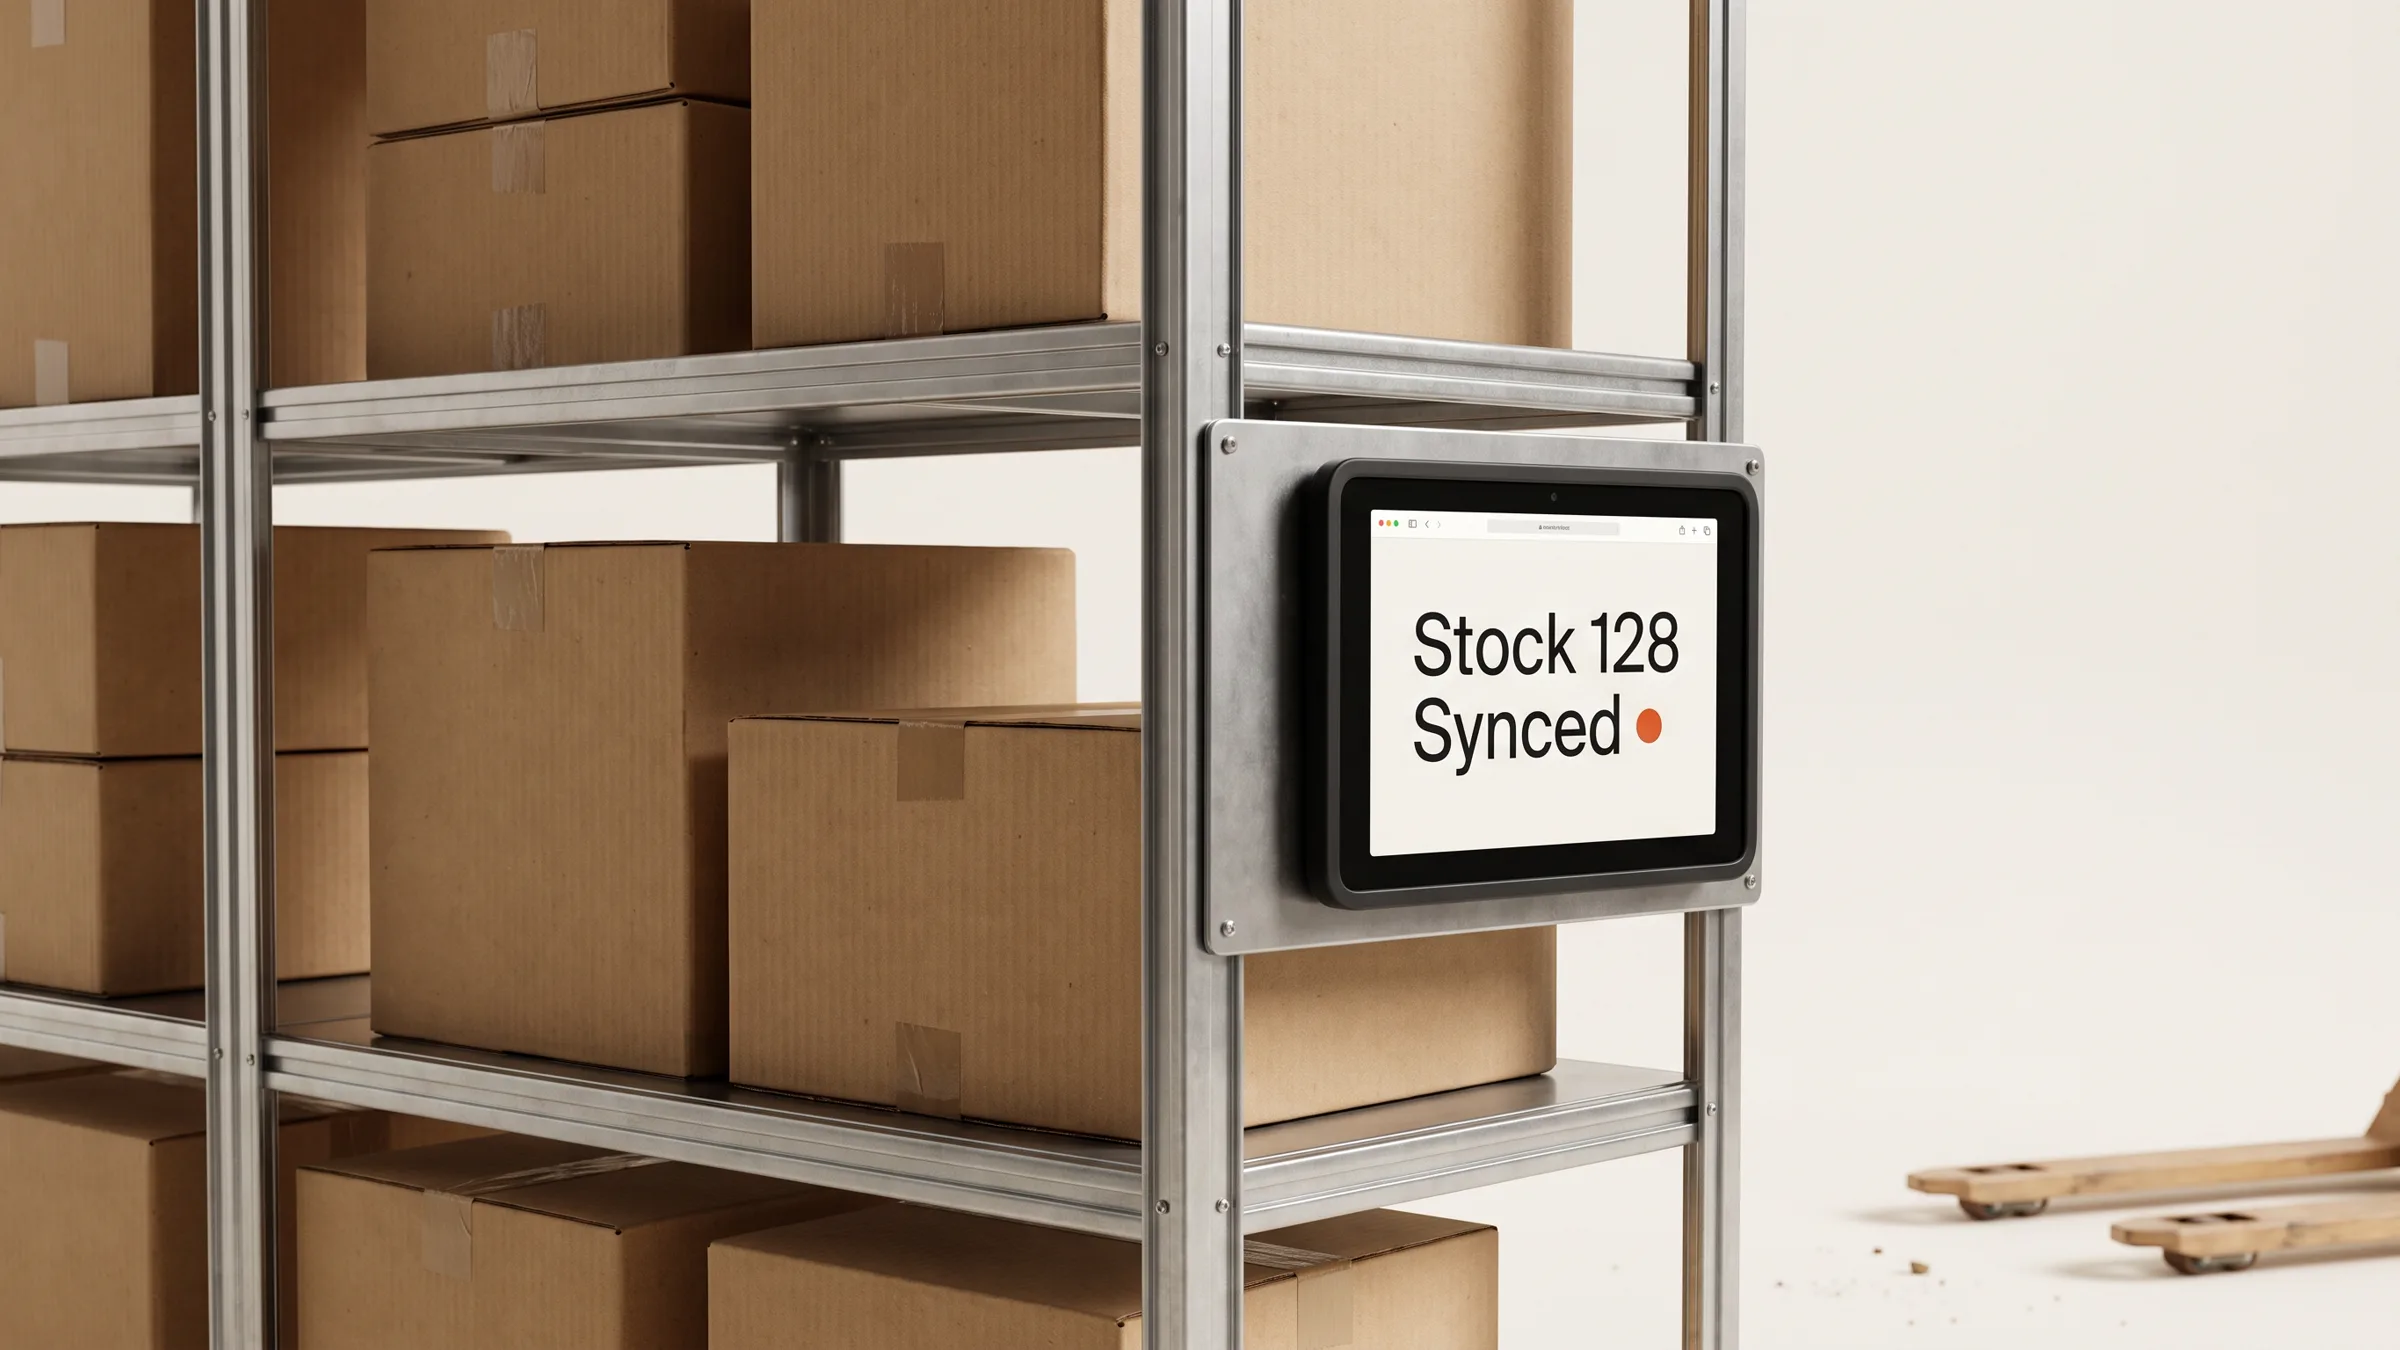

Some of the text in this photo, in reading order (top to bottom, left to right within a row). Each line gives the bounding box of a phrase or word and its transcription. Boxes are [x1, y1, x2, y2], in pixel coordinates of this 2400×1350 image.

[1414, 611, 1680, 677] Stock 128
[1413, 693, 1621, 777] Synced
